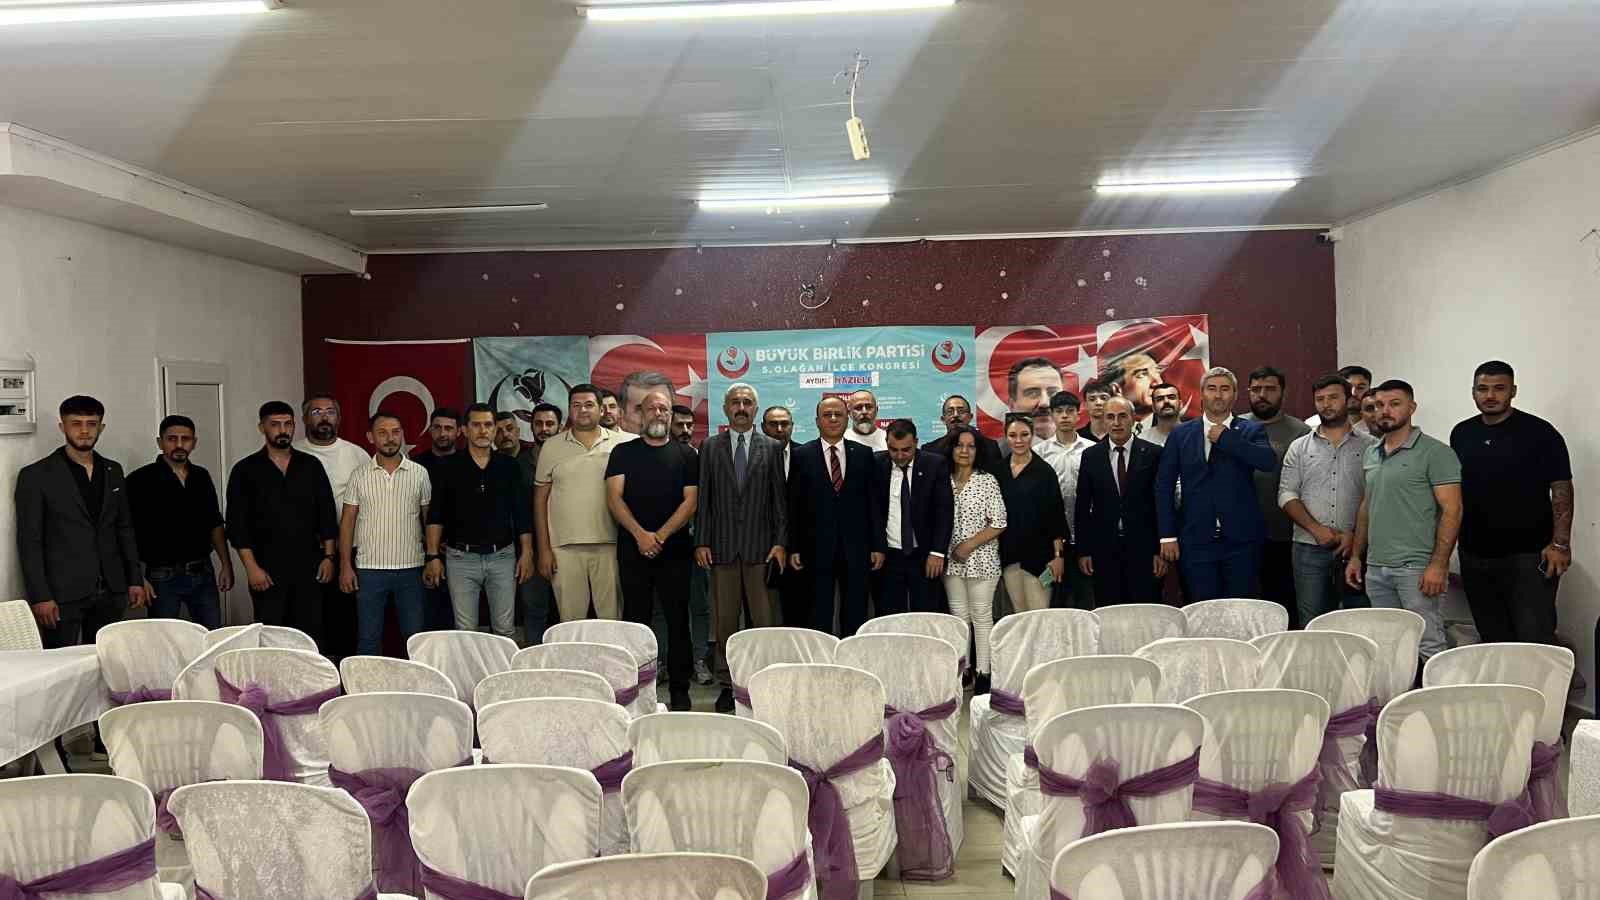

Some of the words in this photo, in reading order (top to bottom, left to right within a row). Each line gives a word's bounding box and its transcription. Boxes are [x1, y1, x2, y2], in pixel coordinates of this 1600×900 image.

[755, 347, 808, 361] BÜYÜK
[813, 346, 862, 360] BİRLİK
[866, 344, 925, 359] PARTİSİ
[859, 360, 920, 371] KONGRESİ
